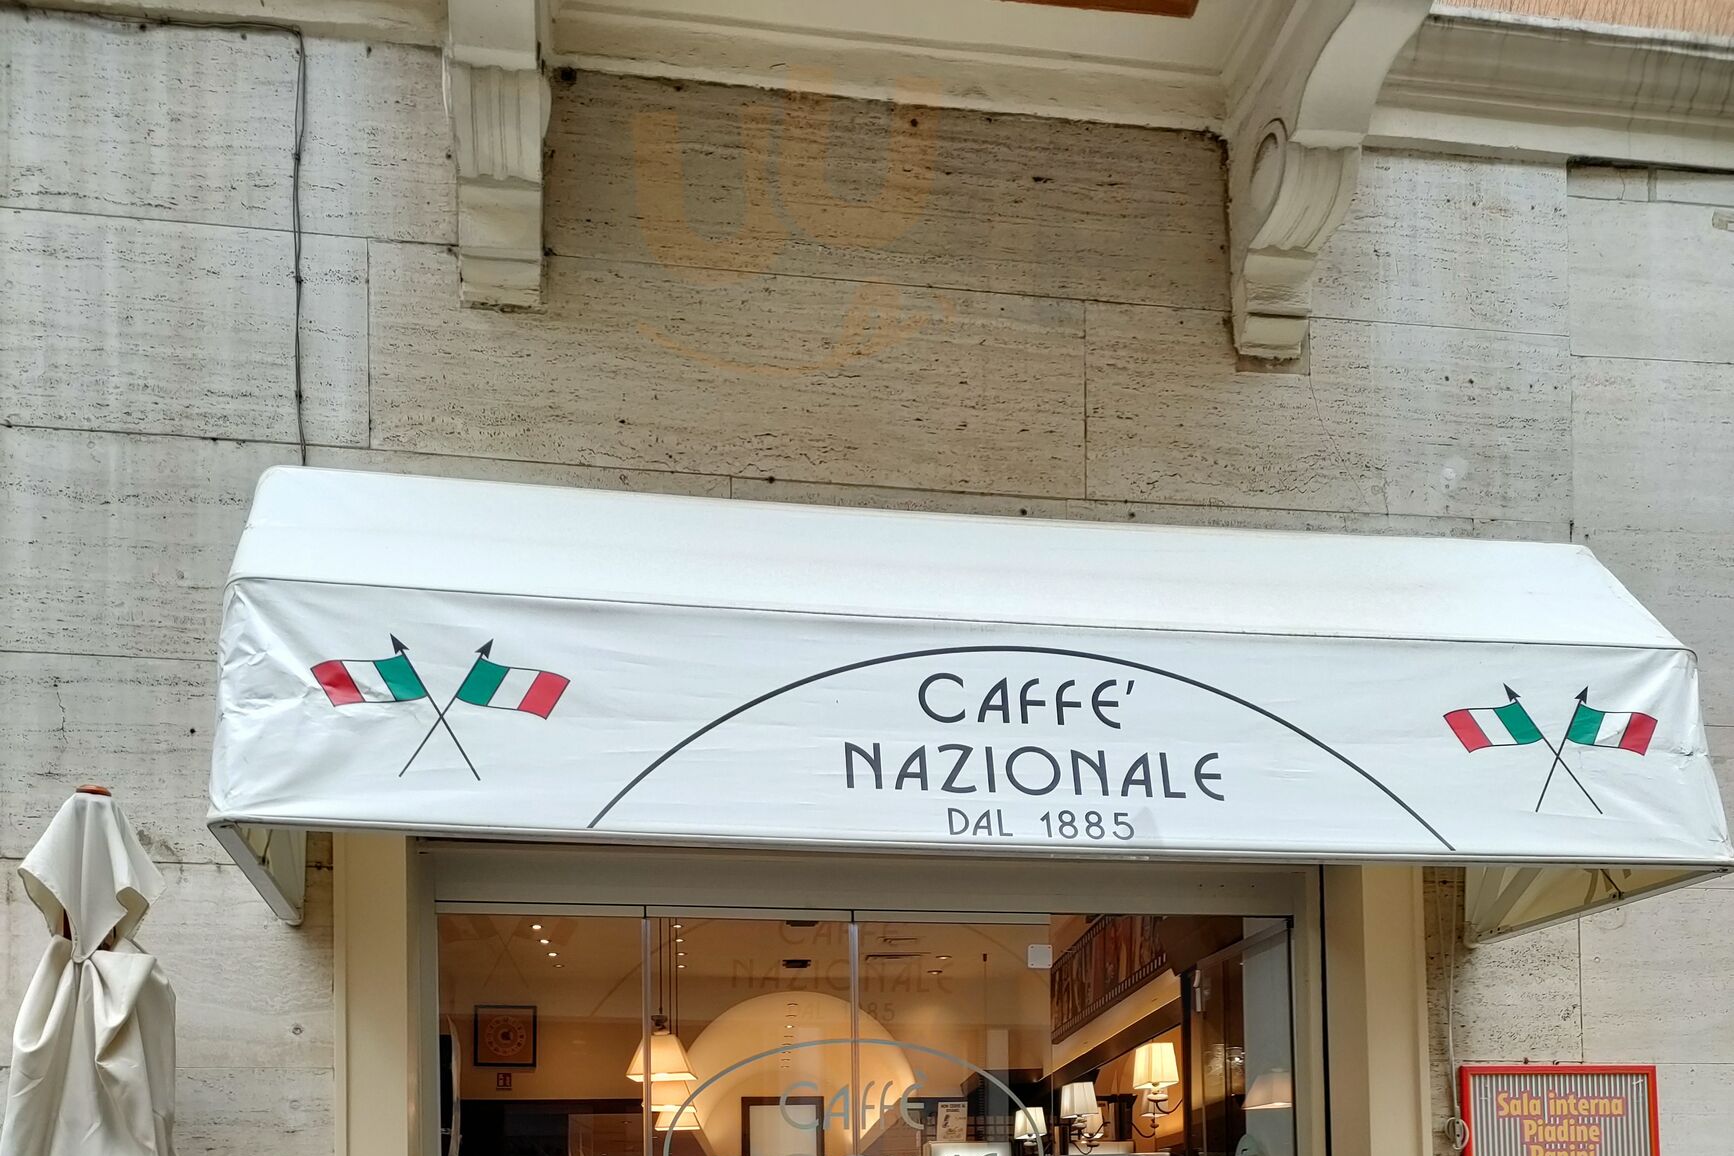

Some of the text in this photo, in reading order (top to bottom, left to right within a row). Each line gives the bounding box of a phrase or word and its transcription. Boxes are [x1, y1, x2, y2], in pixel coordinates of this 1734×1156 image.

[844, 742, 1225, 801] NAZIONALE
[947, 806, 1136, 841] DAL 1885
[1498, 1092, 1623, 1116] Sala interna
[1523, 1119, 1600, 1142] Piadine
